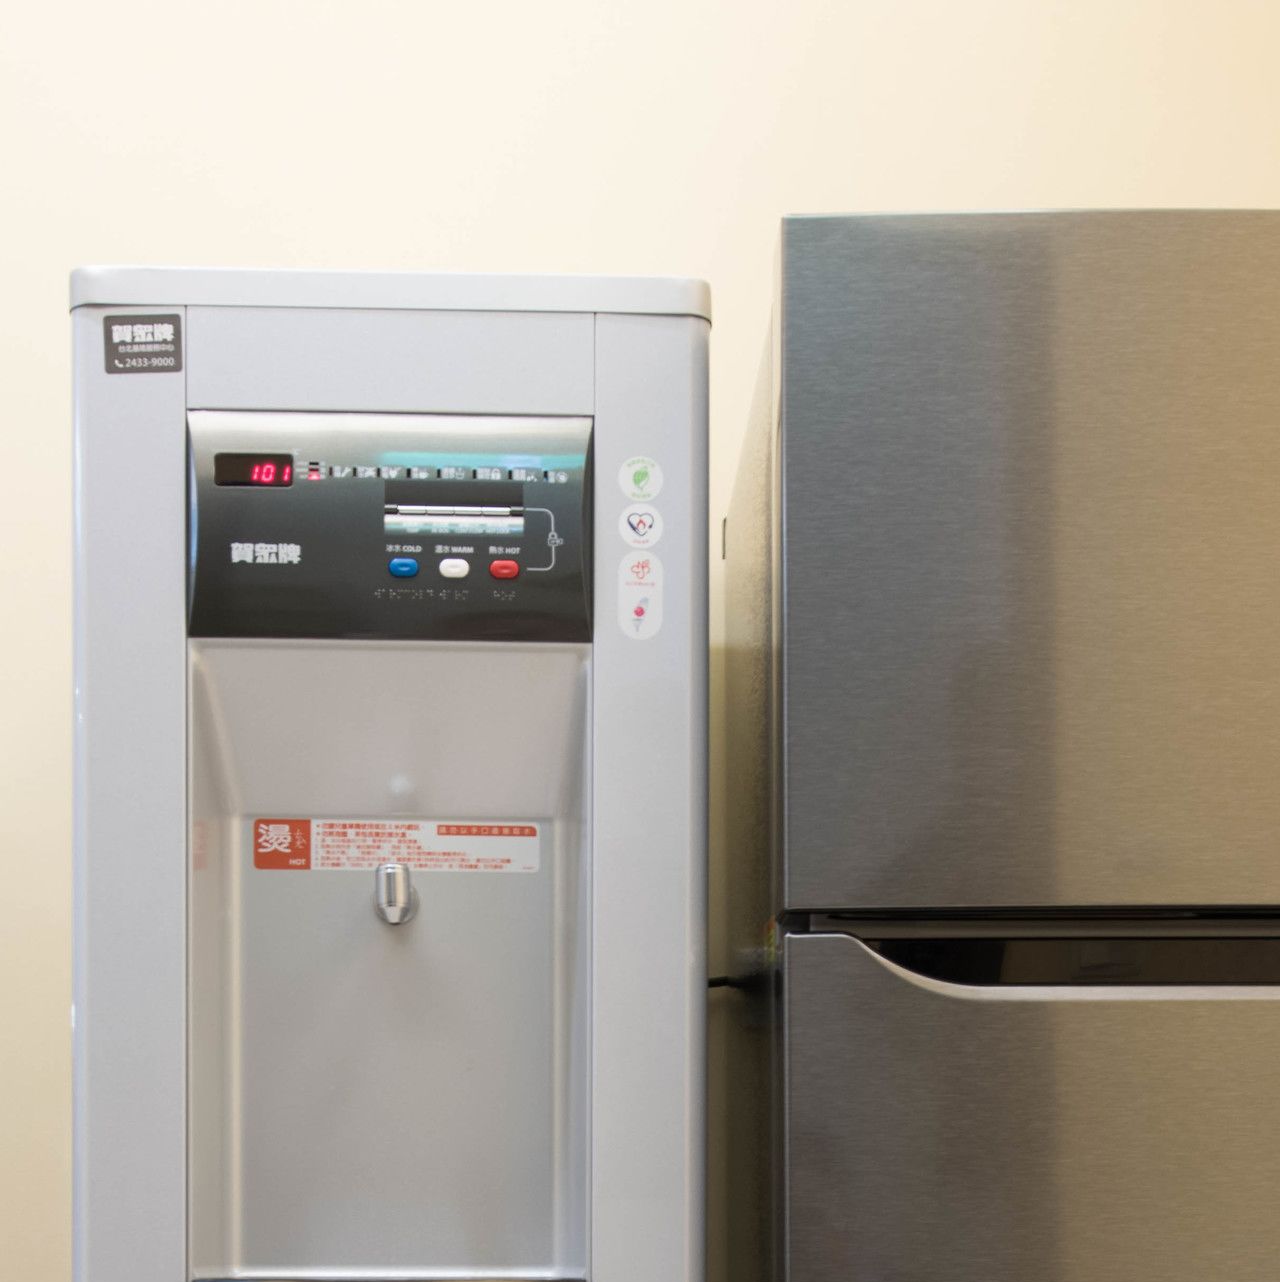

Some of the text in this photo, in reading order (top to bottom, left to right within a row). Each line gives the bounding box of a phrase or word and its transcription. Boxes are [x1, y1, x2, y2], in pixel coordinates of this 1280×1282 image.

[125, 356, 175, 368] 2433-9000
[250, 464, 292, 482] 101
[401, 545, 423, 553] COLD
[451, 546, 475, 554] WARM
[504, 547, 521, 555] HOT
[257, 823, 292, 853] 燙
[288, 858, 307, 866] HOT
